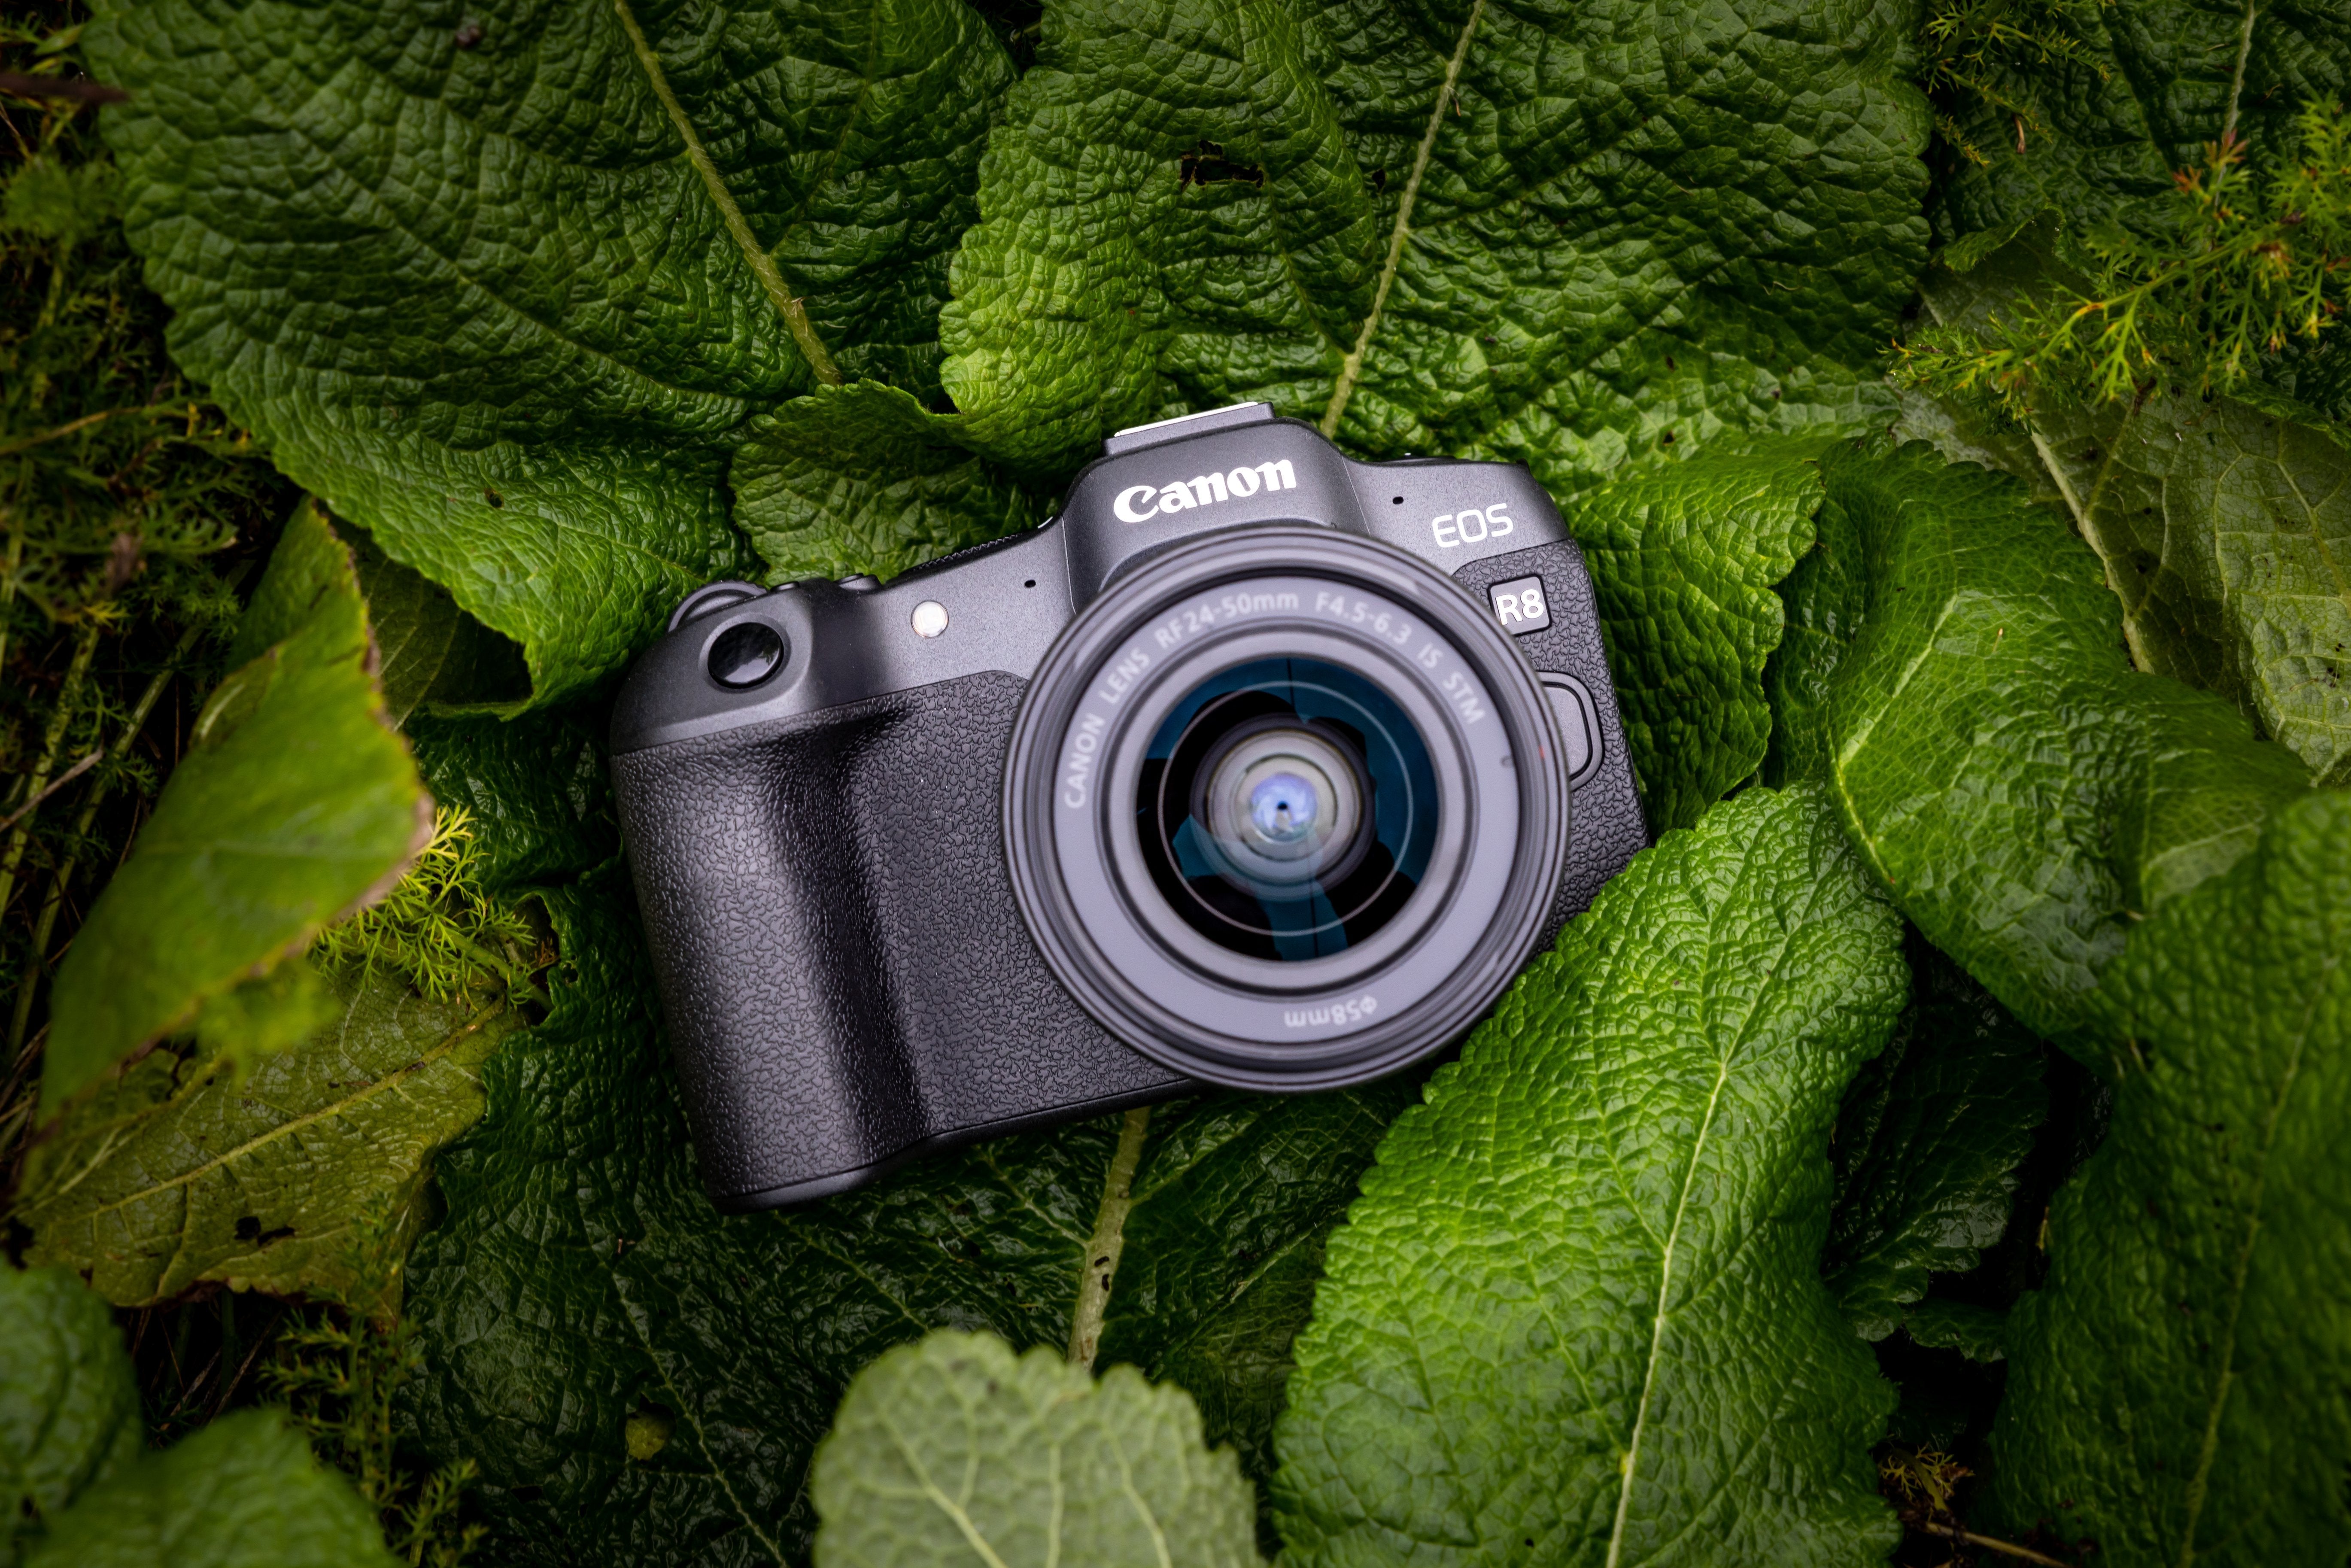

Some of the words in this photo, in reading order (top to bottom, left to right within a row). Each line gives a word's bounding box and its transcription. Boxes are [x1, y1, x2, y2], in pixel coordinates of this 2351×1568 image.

[1114, 459, 1297, 523] Canon
[1432, 503, 1513, 548] EOS
[1495, 589, 1543, 625] R8
[1065, 713, 1105, 809] CANON
[1099, 648, 1150, 704] LENS
[1315, 592, 1412, 645] F4.5-6.3
[1418, 643, 1444, 669] IS
[1443, 672, 1485, 725] STM
